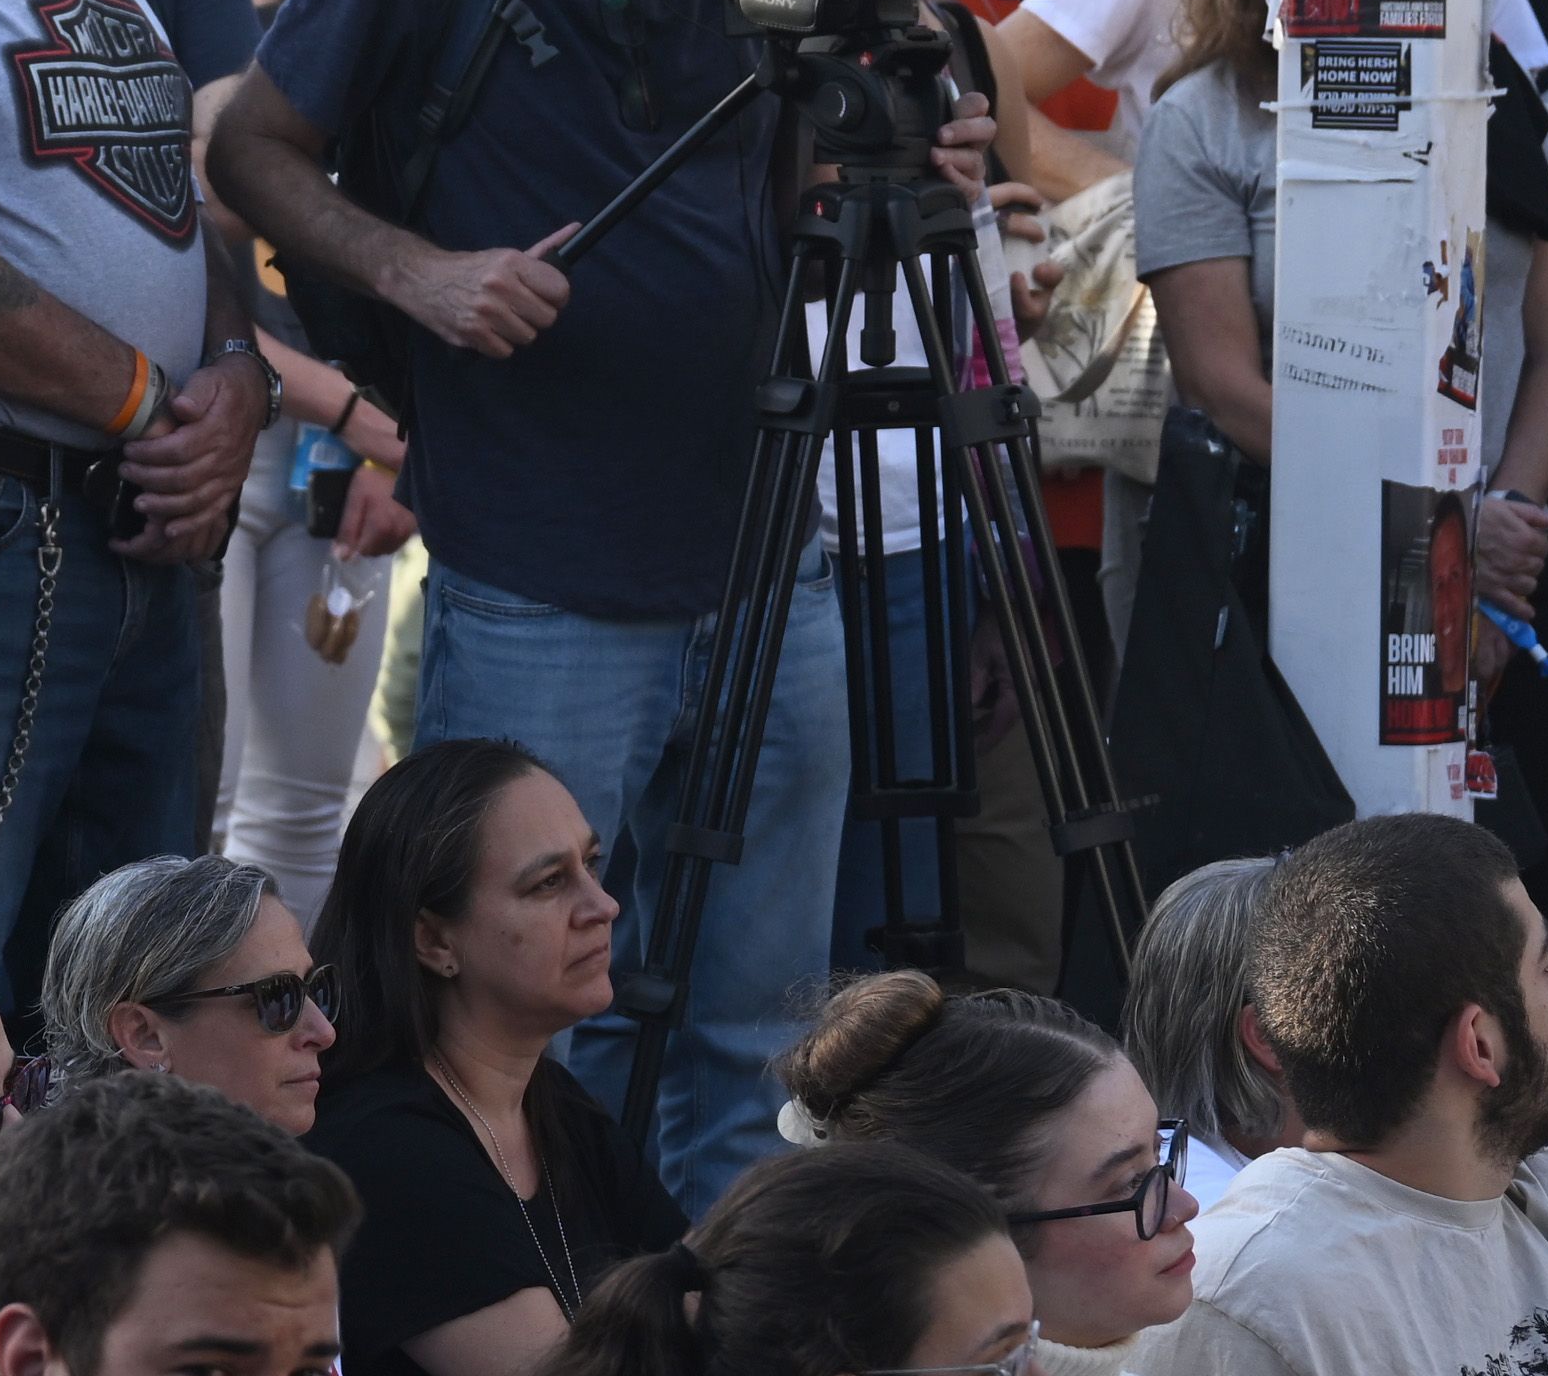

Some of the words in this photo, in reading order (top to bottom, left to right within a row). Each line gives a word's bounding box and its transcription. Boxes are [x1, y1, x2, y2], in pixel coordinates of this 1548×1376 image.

[1318, 56, 1356, 68] BRING
[1358, 57, 1397, 69] HERSH
[1318, 70, 1356, 83] HOME
[1360, 70, 1397, 83] NOW!
[1388, 632, 1436, 663] BRING
[1388, 665, 1424, 696] HIM
